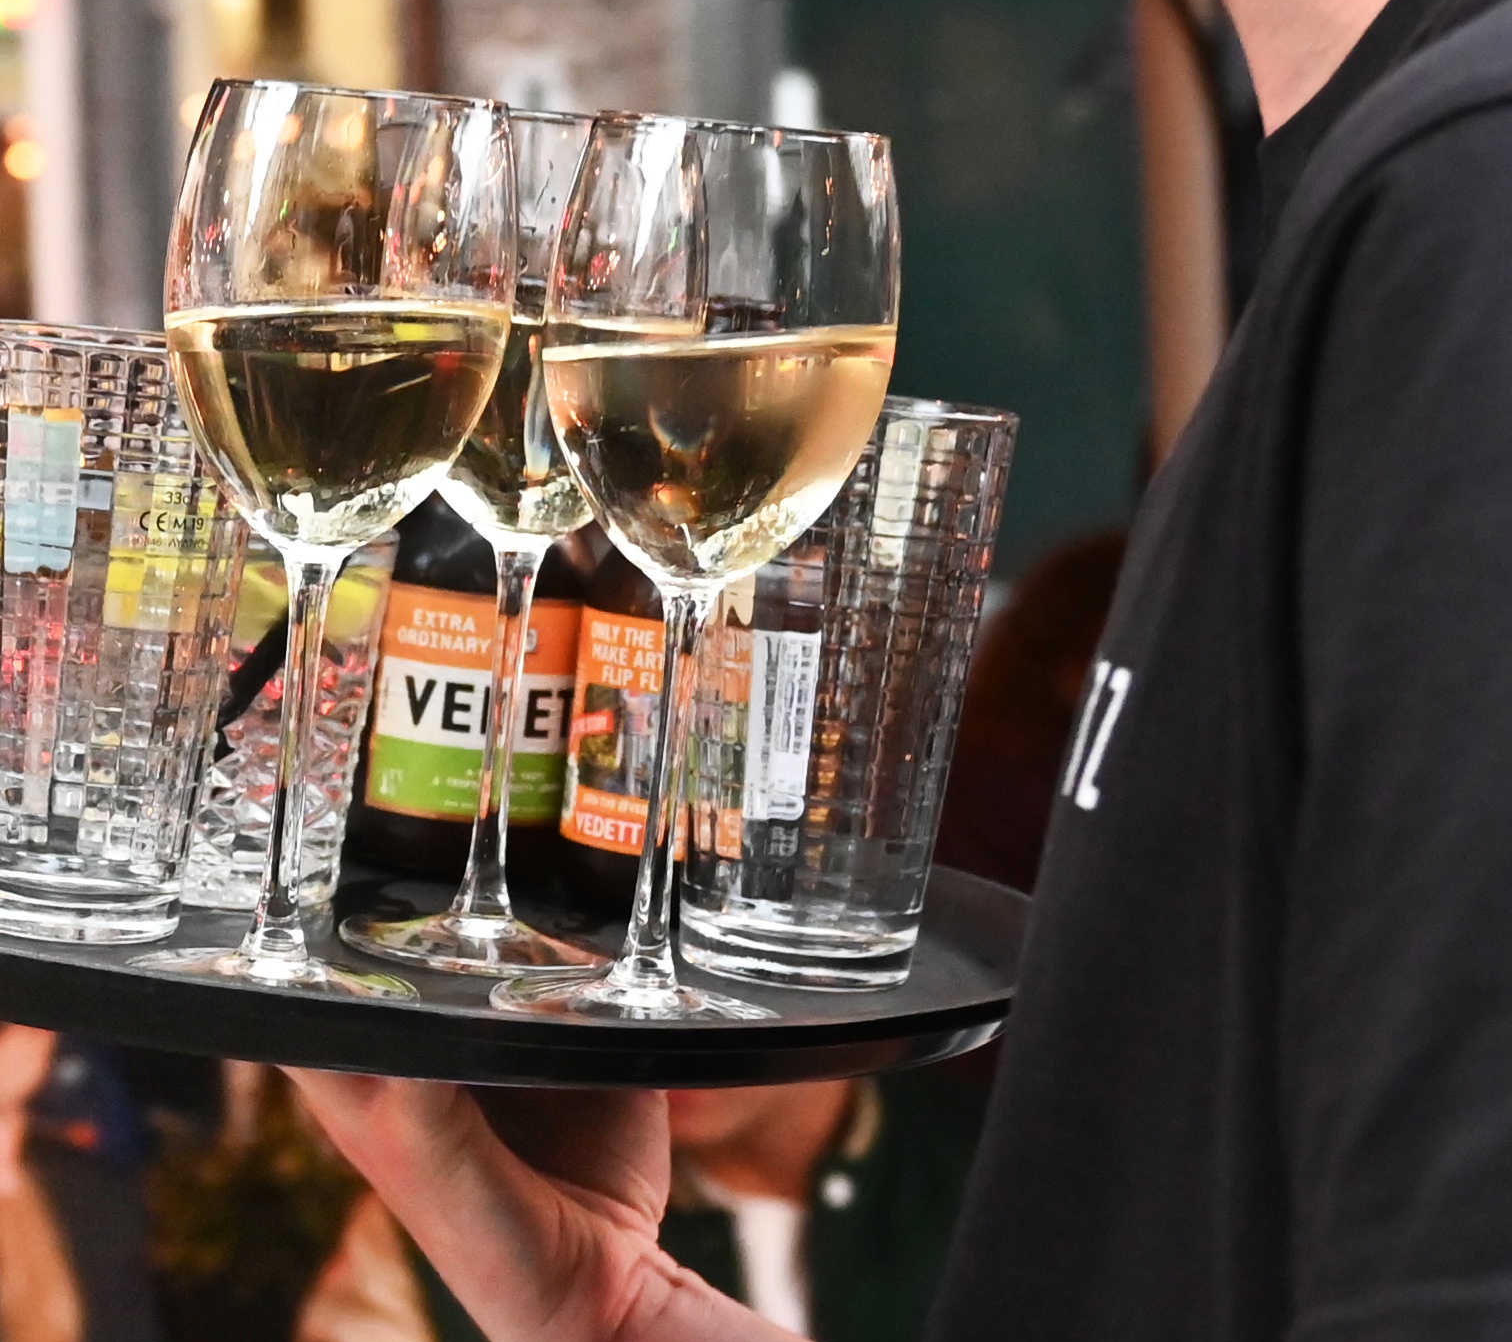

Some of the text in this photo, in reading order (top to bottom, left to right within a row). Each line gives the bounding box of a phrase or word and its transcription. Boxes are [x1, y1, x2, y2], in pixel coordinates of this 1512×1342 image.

[413, 608, 476, 633] EXTRA
[397, 625, 492, 654] ORDINARY
[624, 627, 656, 649] THE
[592, 642, 629, 666] MAKE
[601, 664, 634, 687] FLIP
[576, 811, 643, 846] VEDETT
